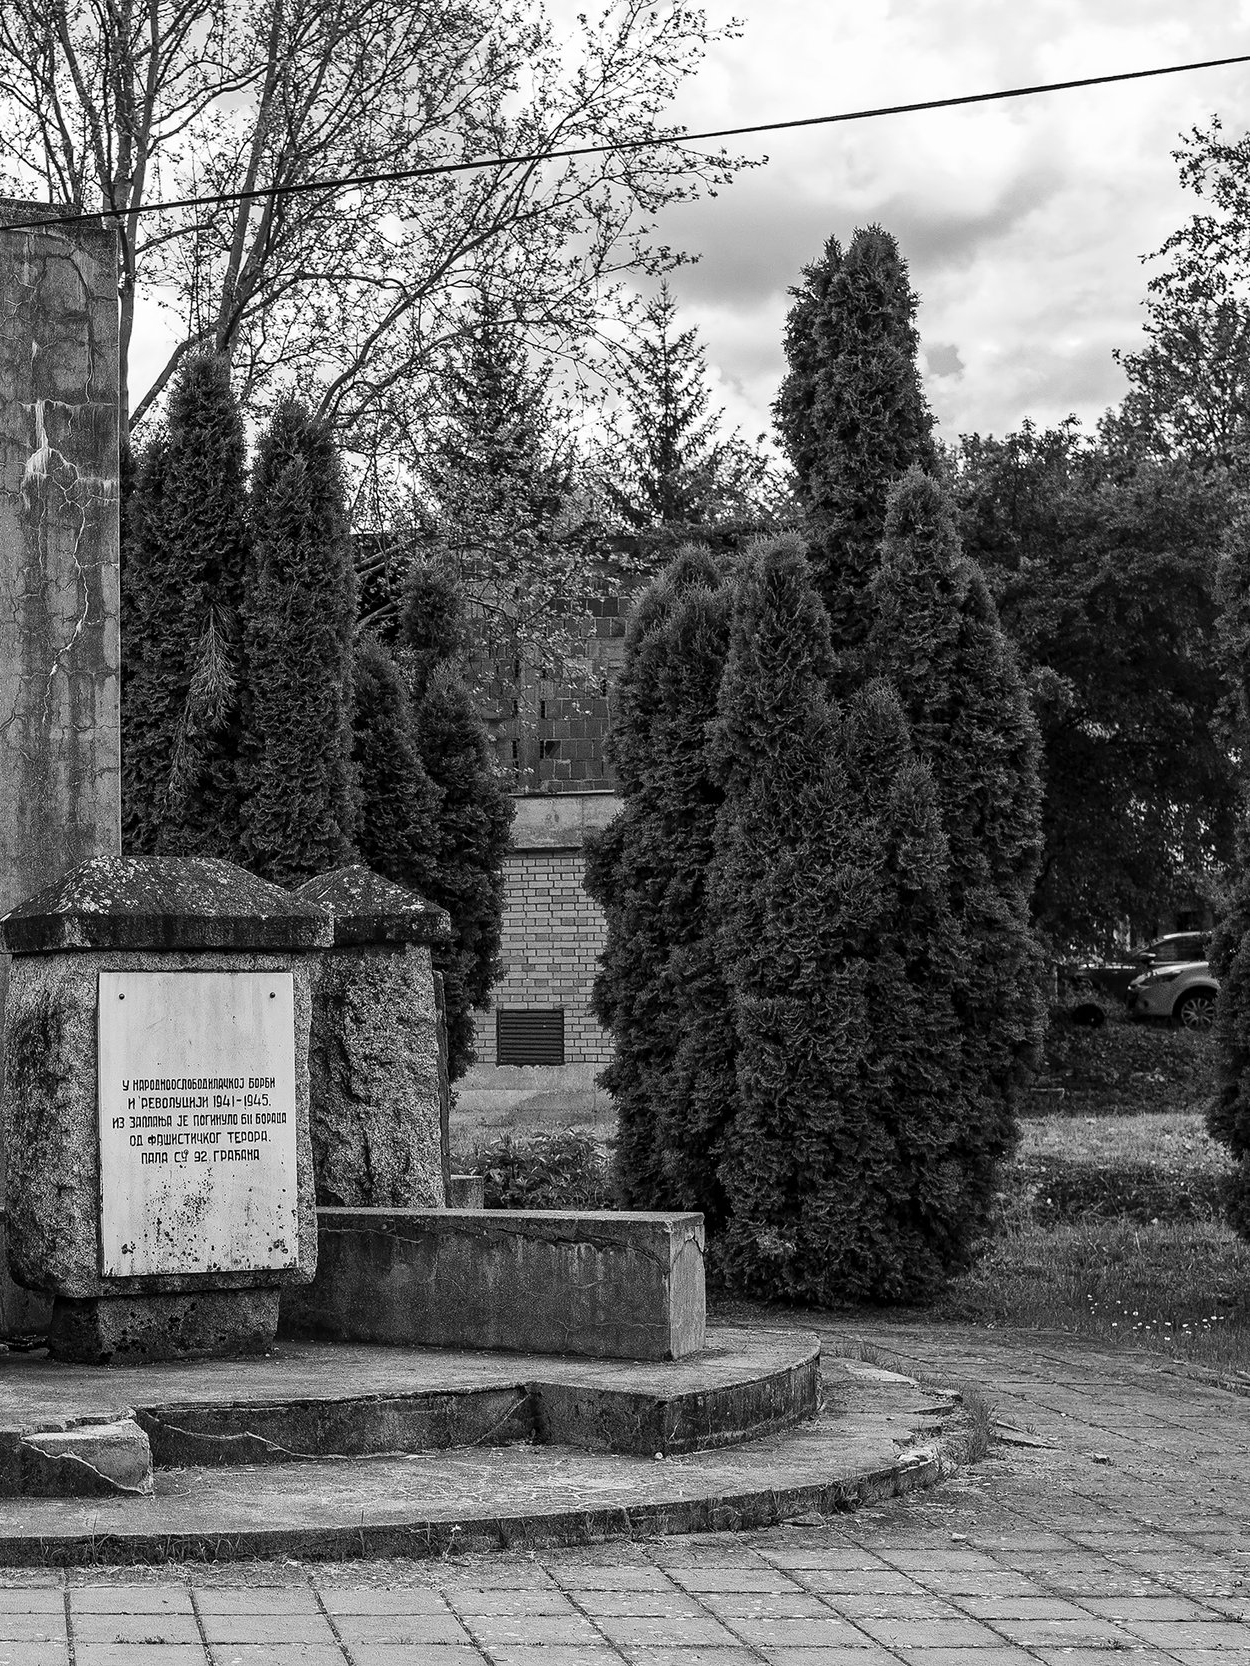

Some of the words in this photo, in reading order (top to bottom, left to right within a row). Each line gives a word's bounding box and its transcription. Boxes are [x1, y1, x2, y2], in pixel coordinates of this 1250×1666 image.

[122, 1080, 129, 1091] У
[133, 1078, 244, 1091] НАРОДНООСЛОБОДИЛАЧКОЈ
[248, 1077, 275, 1089] БОРБИ
[128, 1098, 135, 1109] И
[141, 1096, 208, 1109] РЕВОЛУЦИЈИ
[112, 1117, 125, 1129] ИЗ
[129, 1115, 172, 1128] ЗАПЛАЊА
[177, 1115, 188, 1127] ЈЕ
[193, 1114, 238, 1126] ПОГИНУЛО
[255, 1112, 287, 1125] БОРАЦА
[129, 1135, 143, 1147] ОД
[147, 1132, 221, 1146] ФАШИСТИЧКОГ
[227, 1131, 271, 1144] ТЕРОРА.
[141, 1151, 168, 1164] ПАЛА
[174, 1150, 188, 1163] СУ
[213, 1149, 260, 1163] ГРАЂАНА
